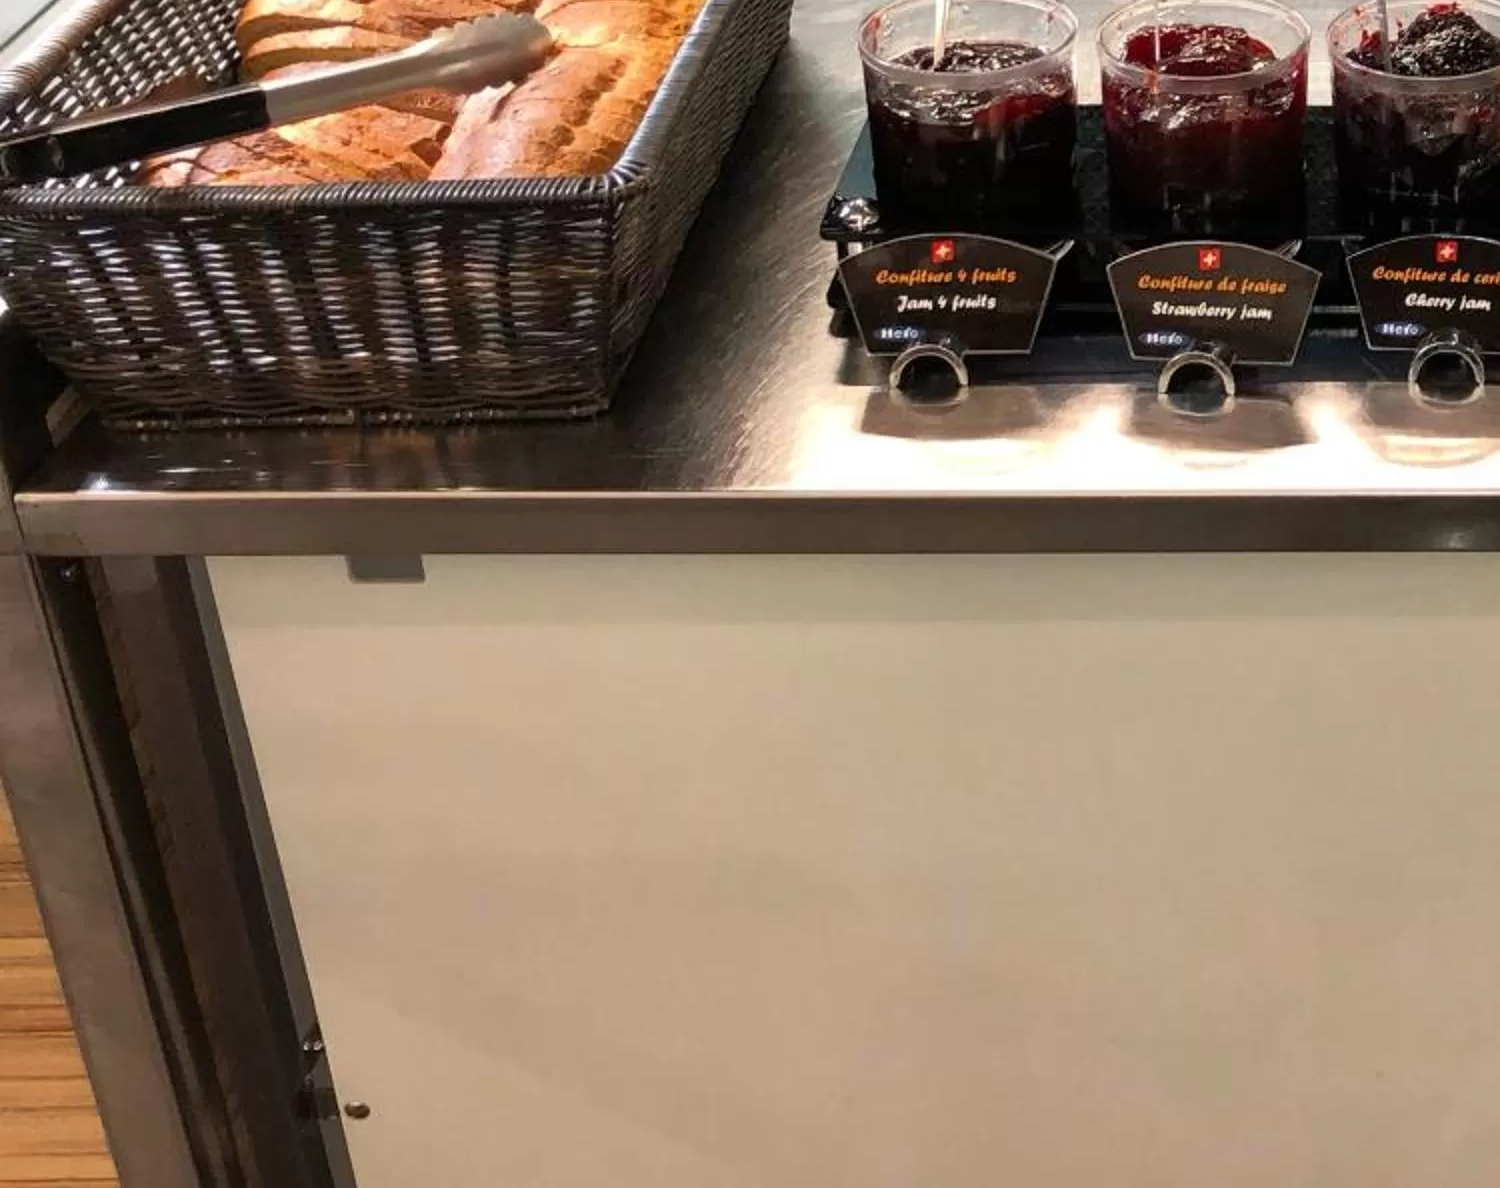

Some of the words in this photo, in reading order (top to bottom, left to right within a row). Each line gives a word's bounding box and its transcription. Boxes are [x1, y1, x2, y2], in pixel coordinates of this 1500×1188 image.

[875, 268, 953, 286] Confiture
[971, 267, 1018, 285] fruits
[1137, 273, 1214, 293] Confiture
[1216, 276, 1238, 292] de
[1372, 265, 1447, 284] Confiture
[1449, 268, 1471, 283] de
[897, 294, 934, 312] Jam
[951, 293, 998, 312] fruits
[1151, 301, 1237, 320] Strawberry
[1239, 303, 1273, 320] jam
[1404, 292, 1457, 311] Cherry
[1459, 293, 1492, 311] jam
